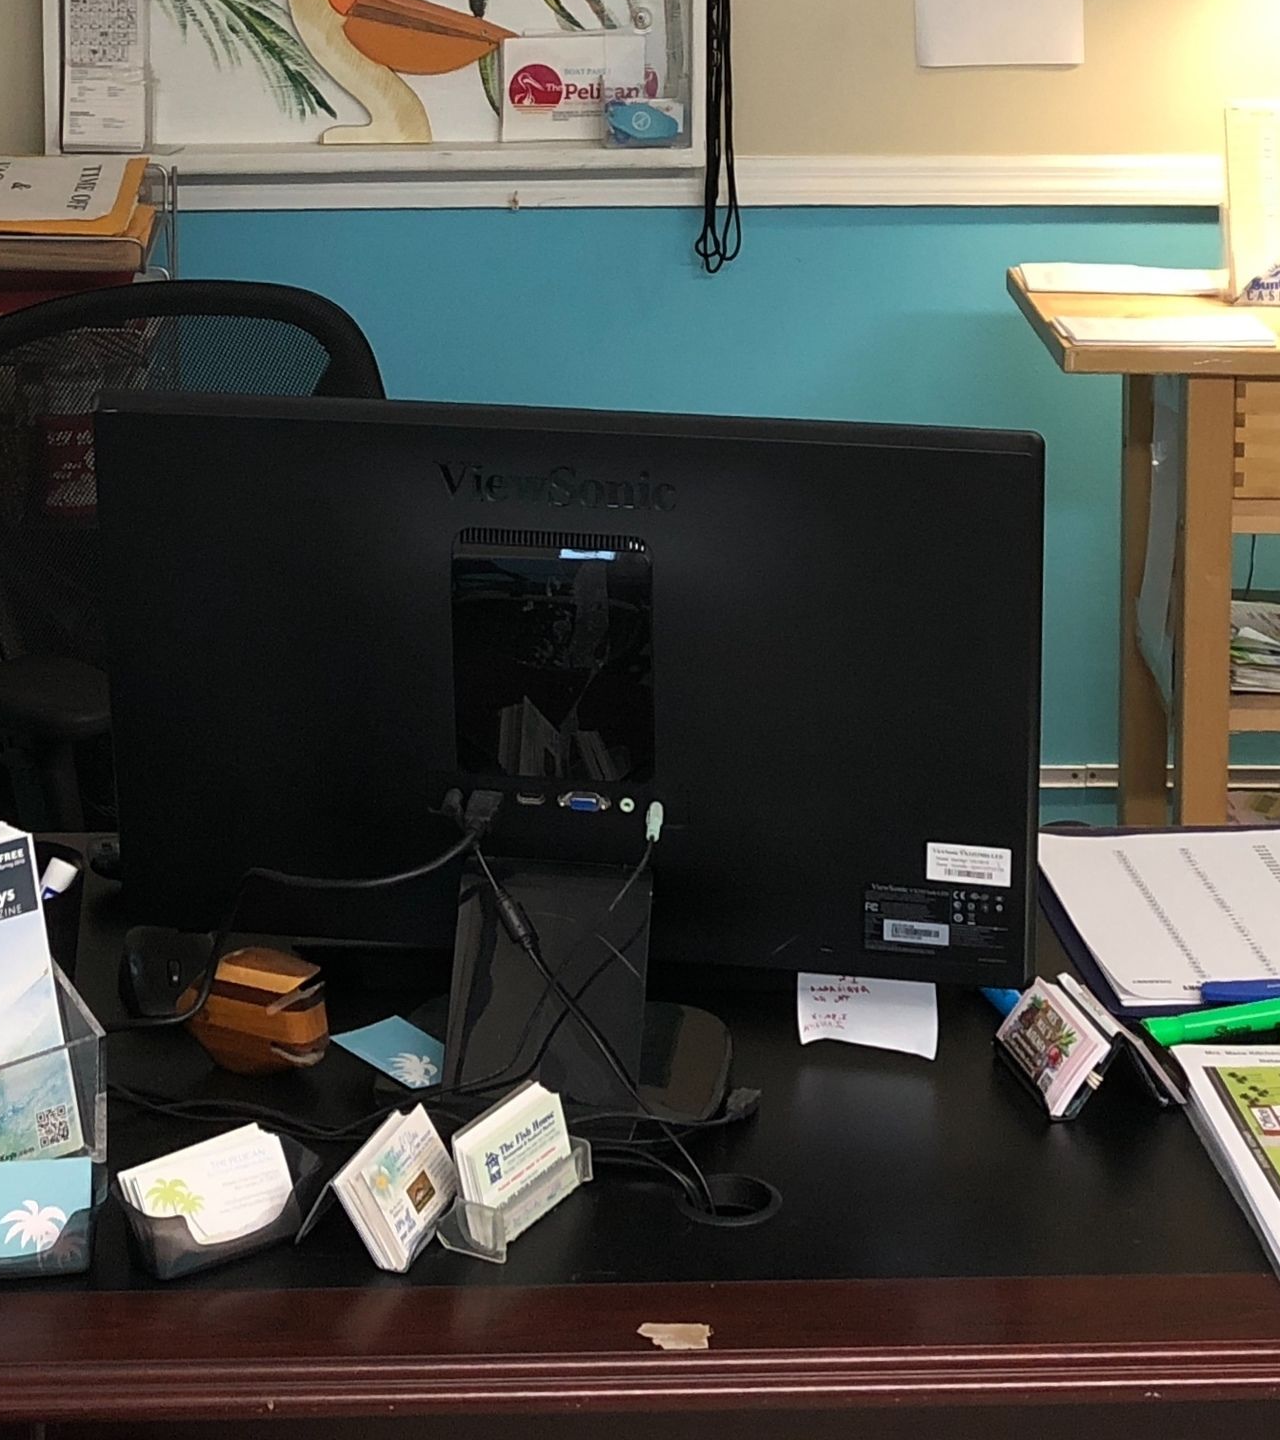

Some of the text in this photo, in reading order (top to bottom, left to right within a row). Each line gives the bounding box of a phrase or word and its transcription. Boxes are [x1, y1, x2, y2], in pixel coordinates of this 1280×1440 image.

[545, 82, 640, 101] The Pelican
[66, 164, 103, 211] TIME OFF
[435, 460, 677, 511] ViewSonic
[499, 1111, 555, 1155] The Fish House
